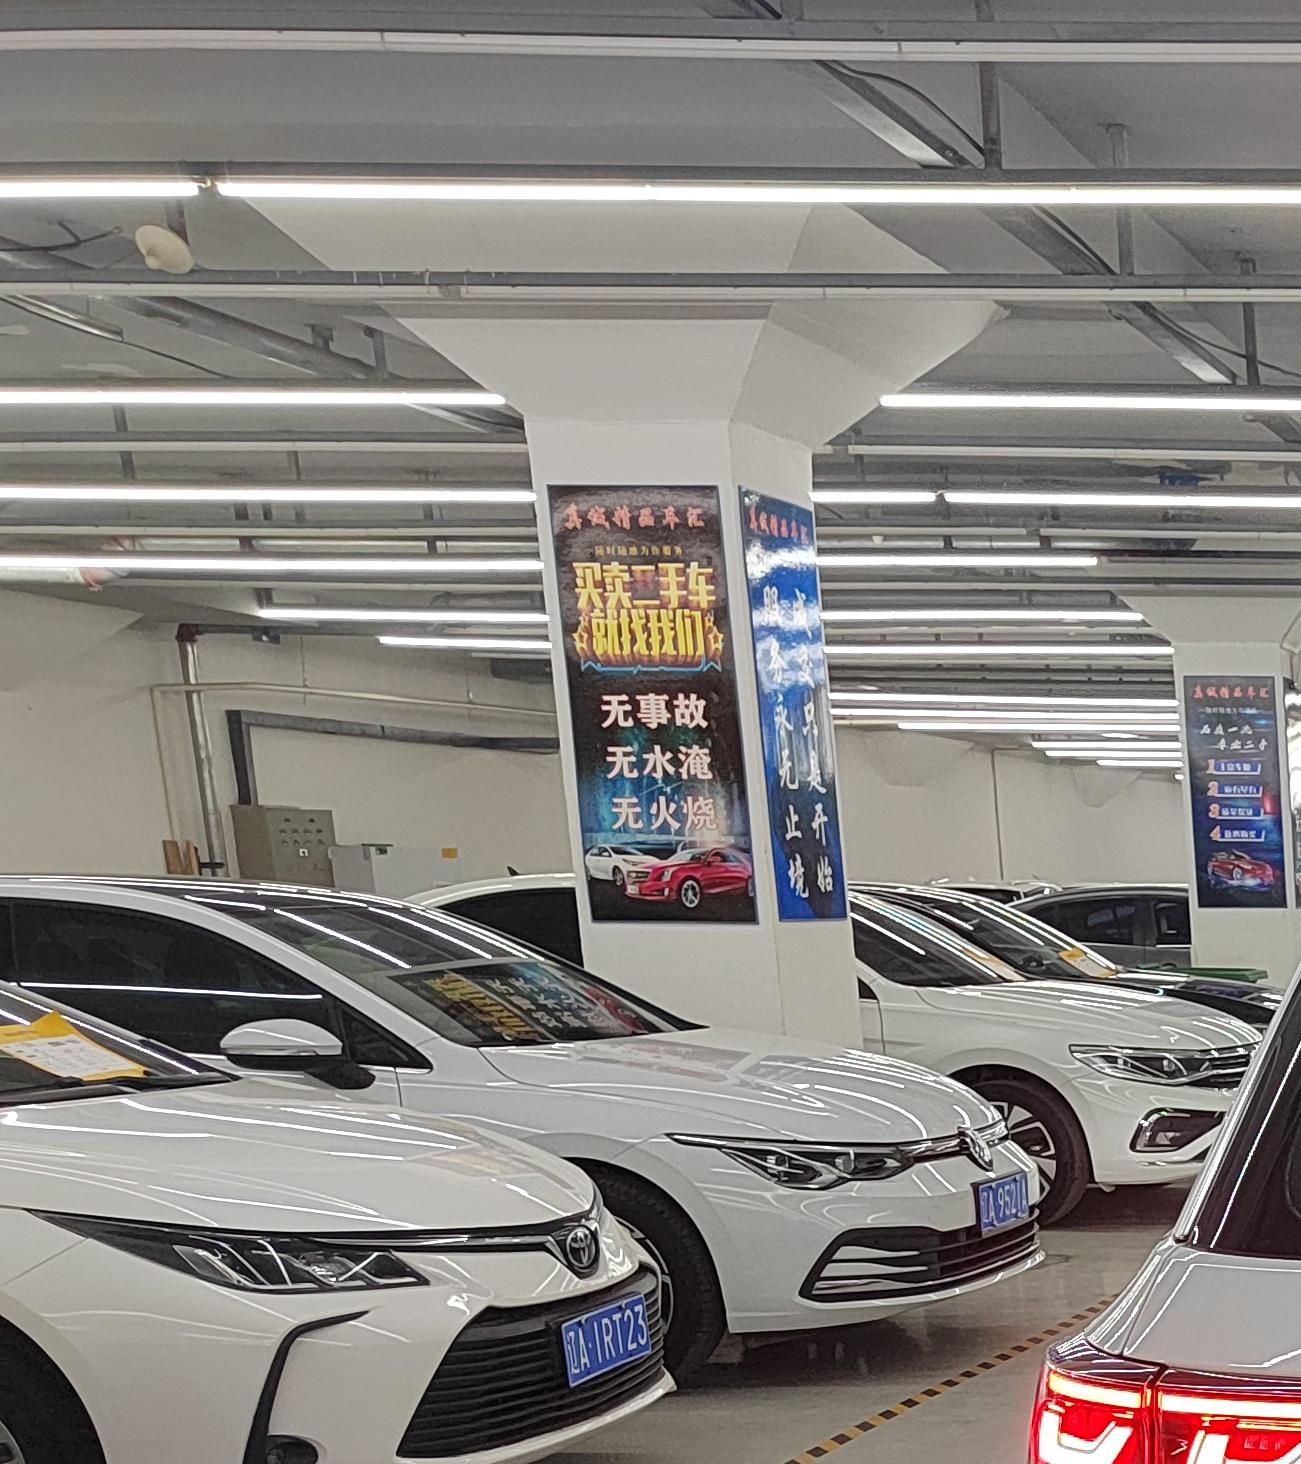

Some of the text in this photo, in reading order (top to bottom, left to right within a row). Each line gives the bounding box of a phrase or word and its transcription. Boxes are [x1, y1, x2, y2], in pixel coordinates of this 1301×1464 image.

[572, 561, 716, 609] 买卖二手车
[591, 608, 705, 657] 就找我们
[600, 692, 709, 730] 无事故
[763, 586, 809, 899] 服务永无止境
[793, 588, 834, 894] 成交只是开始
[605, 745, 714, 781] 无水淹
[1206, 759, 1216, 773] 1
[1207, 781, 1218, 796] 2
[611, 796, 719, 832] 无火烧
[1209, 803, 1220, 818] 3
[1210, 825, 1221, 841] 4
